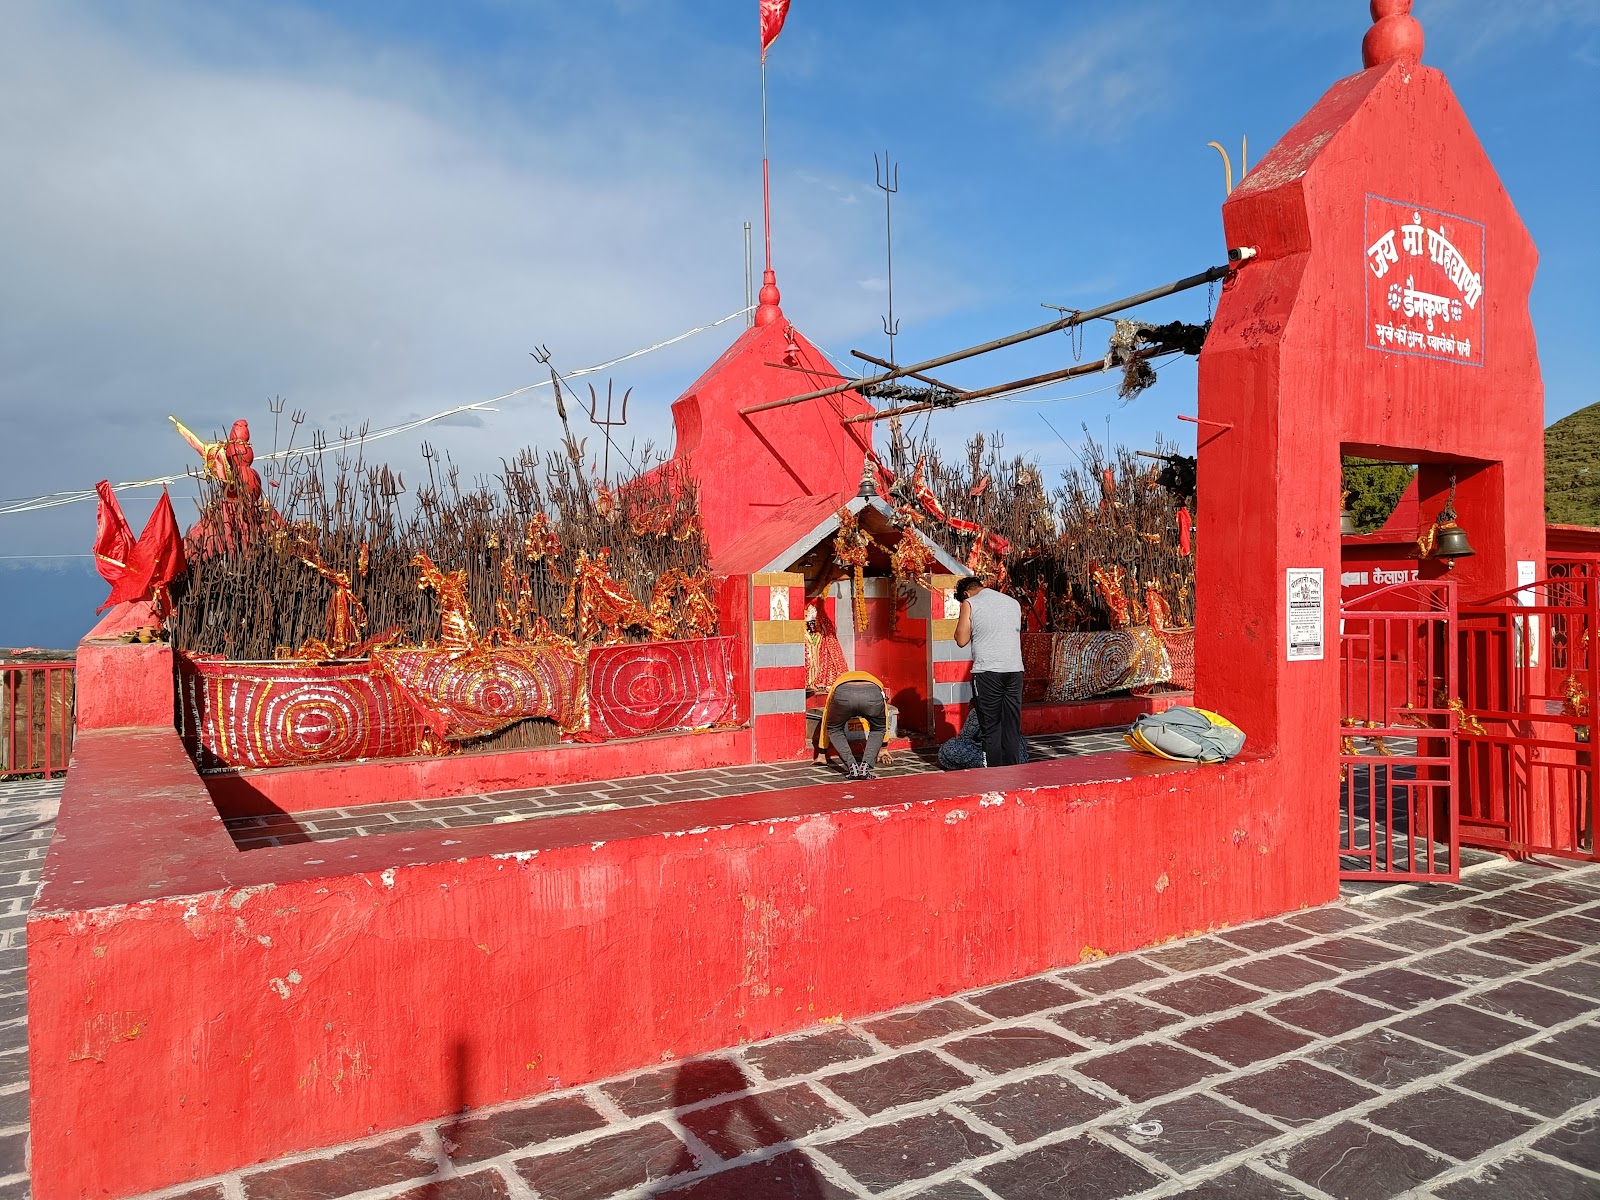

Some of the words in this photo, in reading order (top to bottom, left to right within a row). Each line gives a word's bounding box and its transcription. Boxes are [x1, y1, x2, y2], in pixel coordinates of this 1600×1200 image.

[1367, 229, 1399, 279] जय
[1403, 274, 1450, 332] डैनकुण्ड
[1375, 321, 1394, 346] भूखे
[1457, 338, 1471, 357] पानी
[1373, 567, 1409, 584] कैलाश
